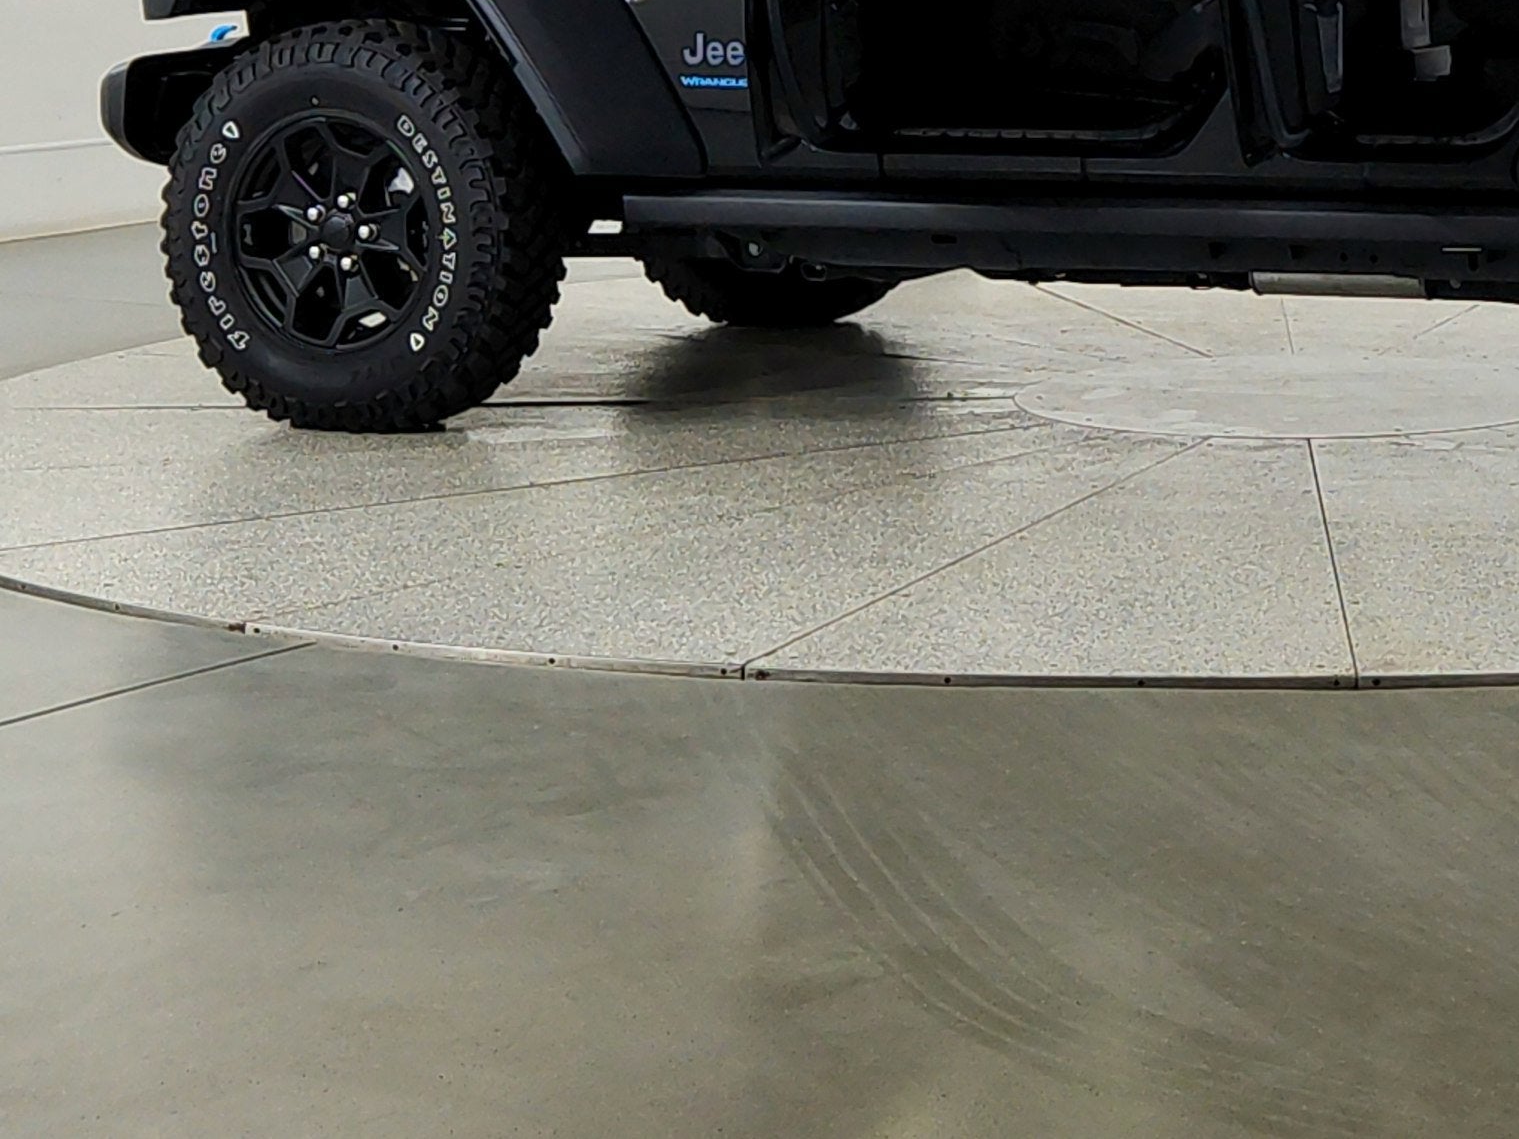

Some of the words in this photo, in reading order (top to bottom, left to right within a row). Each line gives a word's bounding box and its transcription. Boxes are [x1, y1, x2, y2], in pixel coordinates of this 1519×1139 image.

[683, 33, 745, 66] Jee
[680, 75, 748, 87] WRANGLE
[397, 115, 457, 331] DESTINATION
